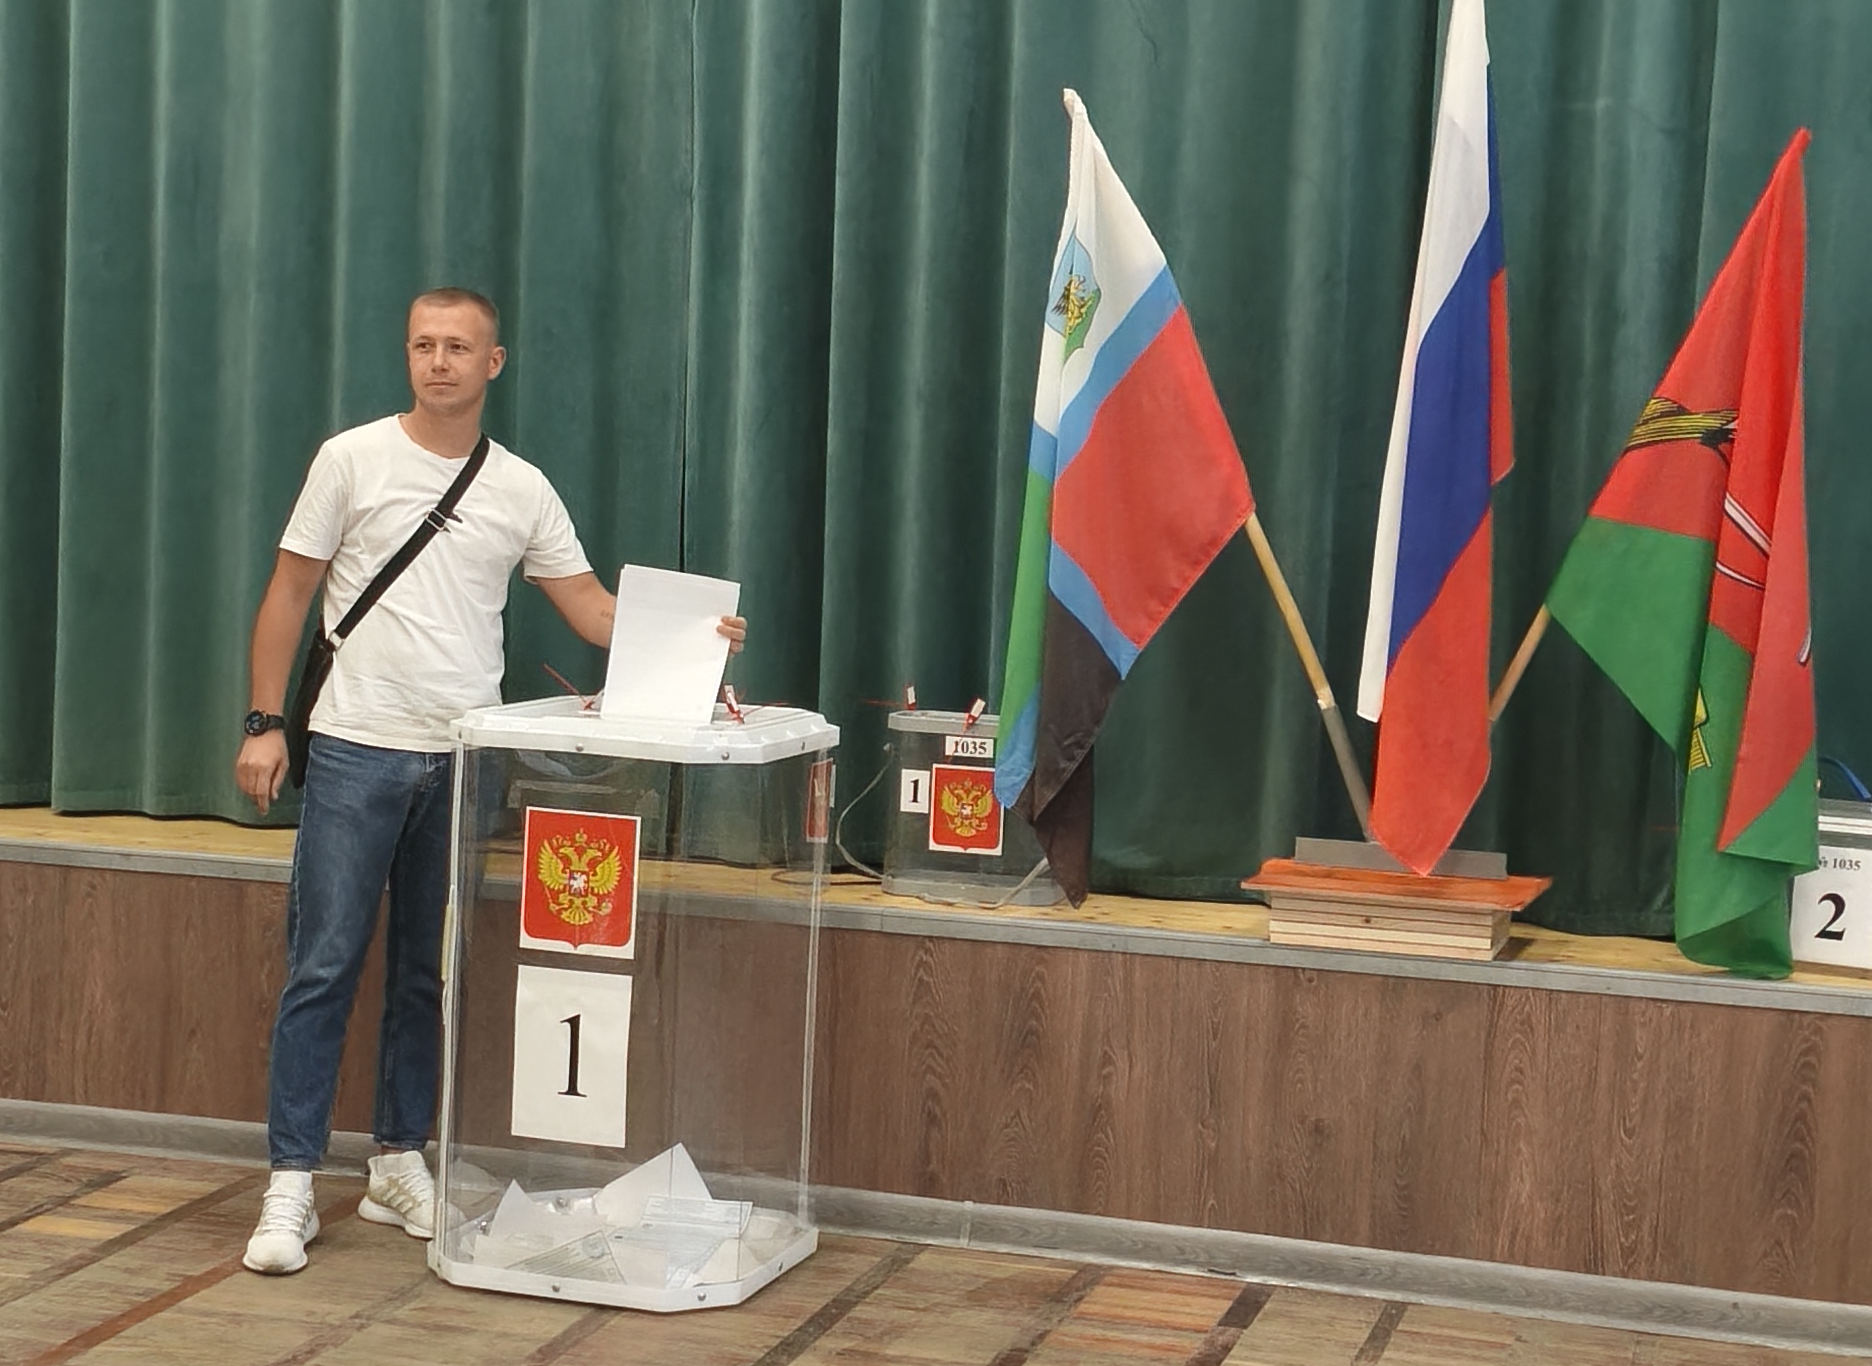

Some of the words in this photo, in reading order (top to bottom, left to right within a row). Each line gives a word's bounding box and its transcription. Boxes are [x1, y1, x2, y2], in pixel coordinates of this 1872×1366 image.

[953, 740, 987, 755] 1035
[909, 778, 920, 804] 1
[1832, 858, 1861, 871] 1035
[1814, 893, 1846, 941] 2
[558, 1014, 588, 1097] 1
